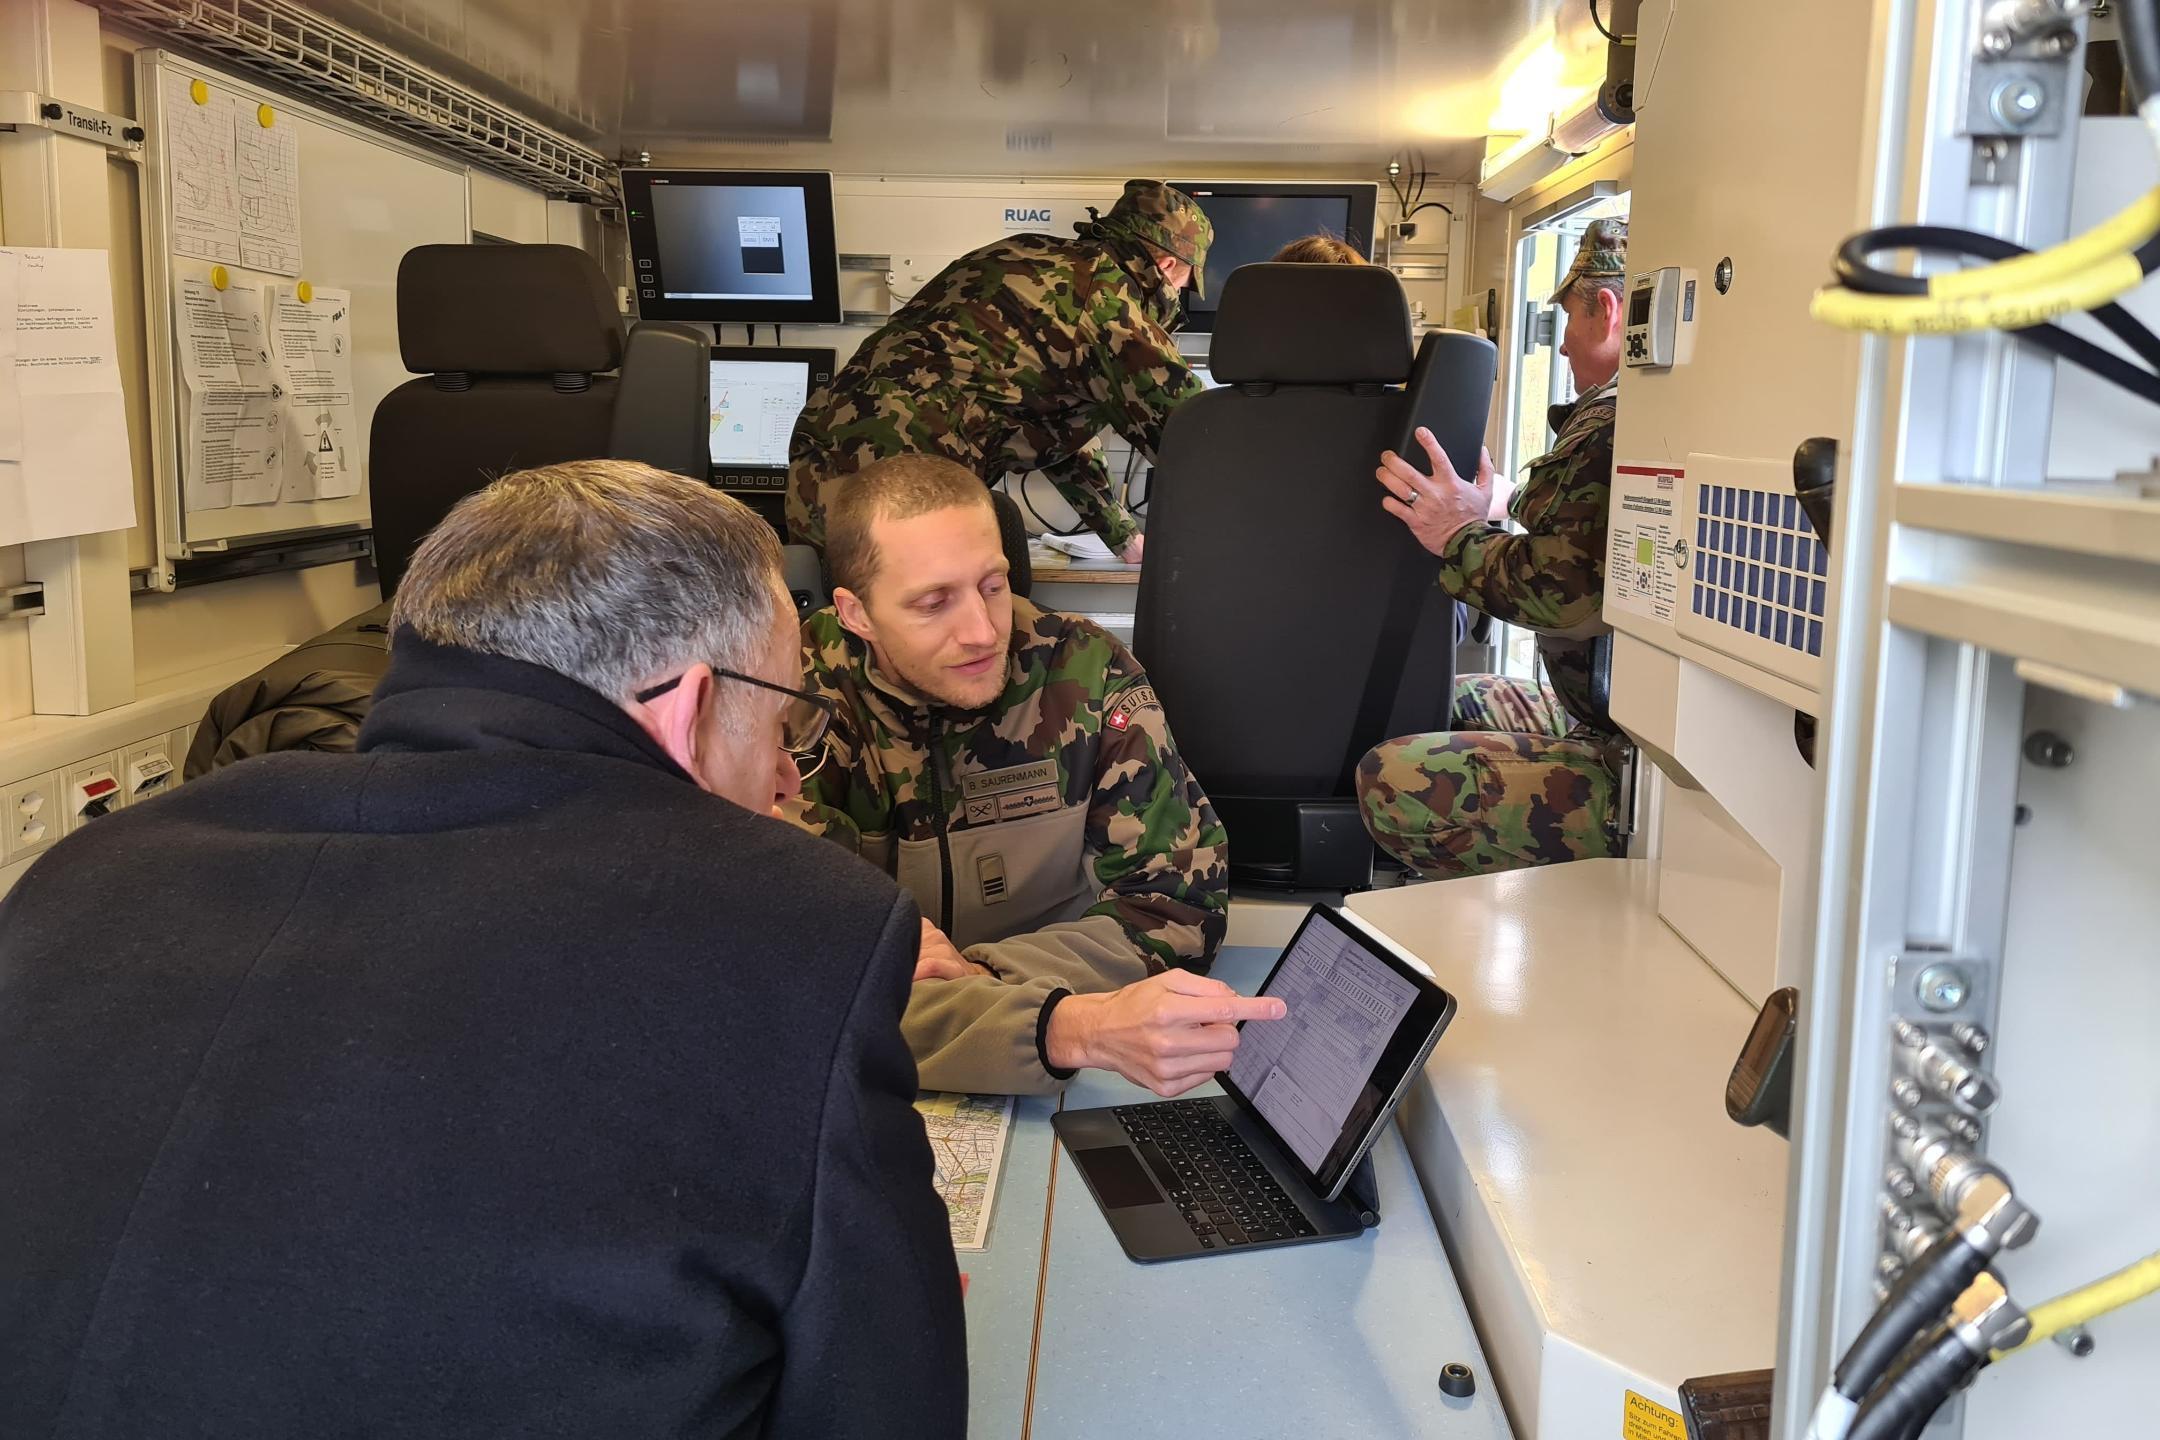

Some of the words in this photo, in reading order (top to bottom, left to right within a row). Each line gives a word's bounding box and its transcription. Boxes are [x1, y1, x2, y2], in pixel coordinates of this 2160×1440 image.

[67, 110, 112, 136] Transit-Fz
[1005, 209, 1051, 221] RUAG
[969, 781, 977, 791] B
[981, 768, 1047, 788] SAURENMANN
[1630, 1397, 1678, 1428] Achtung:
